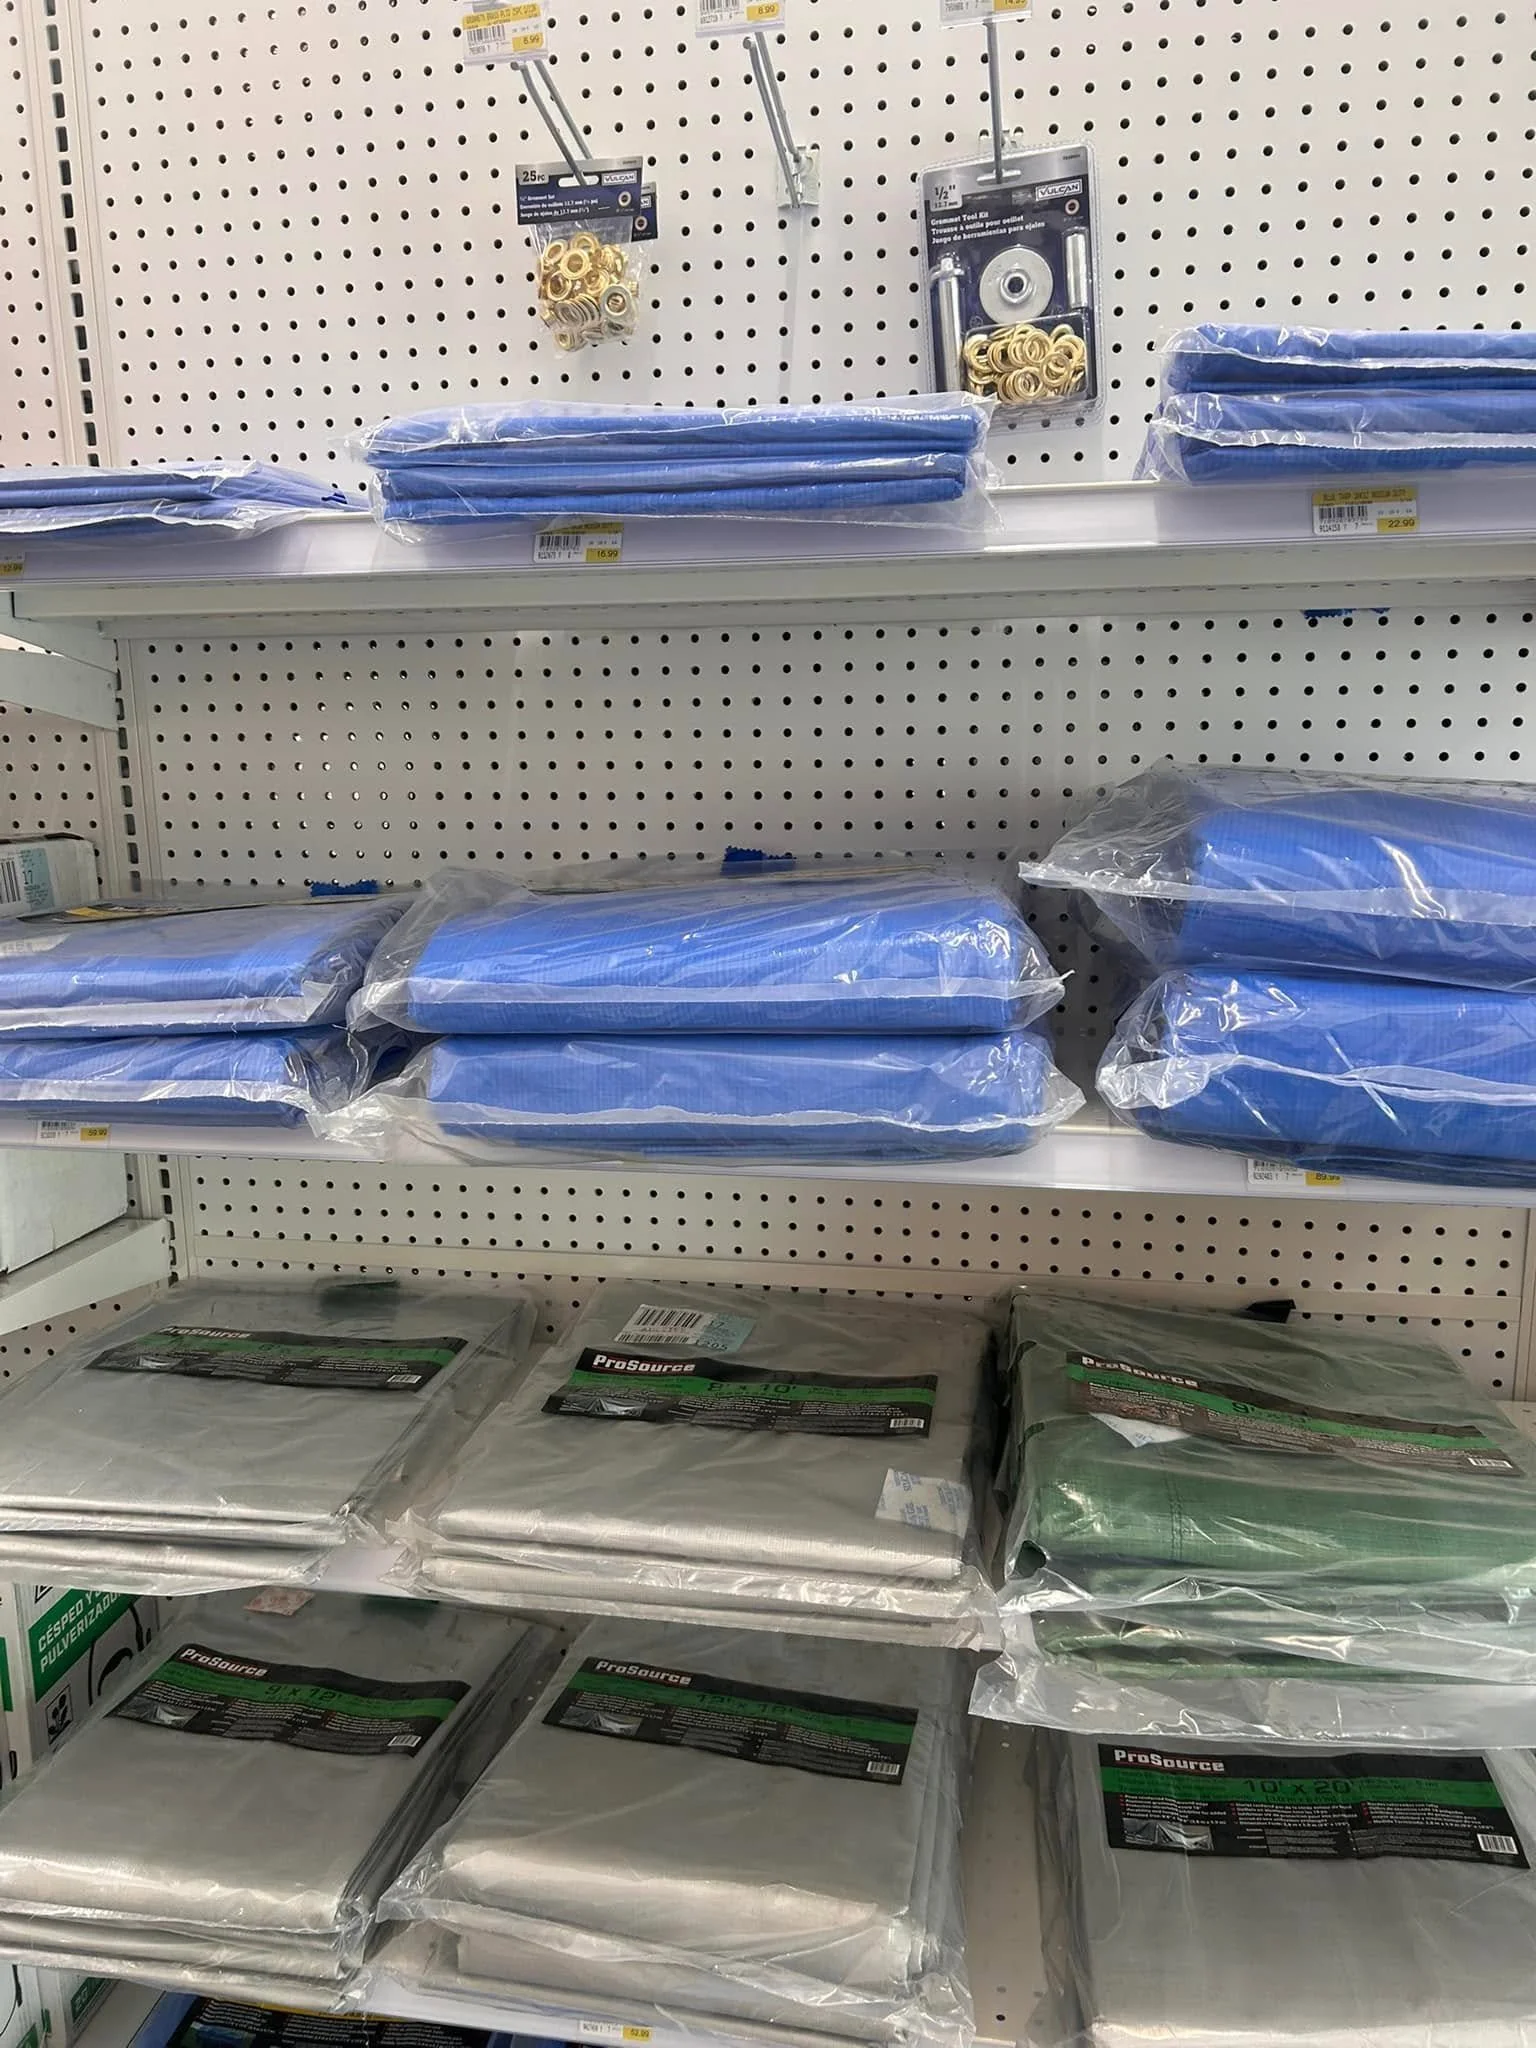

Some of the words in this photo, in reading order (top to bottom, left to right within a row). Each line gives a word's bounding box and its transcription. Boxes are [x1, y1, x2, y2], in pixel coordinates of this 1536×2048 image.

[604, 172, 635, 183] VULCAN
[1039, 183, 1079, 197] VULCAN
[931, 215, 960, 226] Grommet
[961, 212, 978, 221] Tool
[979, 211, 989, 219] Kit
[931, 226, 958, 235] Trousse
[965, 221, 984, 230] outils
[985, 219, 1001, 228] pour
[932, 236, 951, 245] Juego
[962, 228, 1007, 240] herramientas
[1008, 225, 1024, 235] para
[1025, 221, 1046, 231] ojales
[1388, 518, 1416, 528] 22.99
[597, 550, 619, 559] 16.99
[593, 1354, 697, 1372] ProSource
[1081, 1355, 1199, 1388] ProSource
[38, 1599, 84, 1653] CÉSPED
[180, 1648, 268, 1677] ProSource
[595, 1660, 693, 1686] ProSource
[1113, 1749, 1225, 1772] ProSource
[1243, 1779, 1283, 1794] 10'
[1315, 1779, 1353, 1795] 20'
